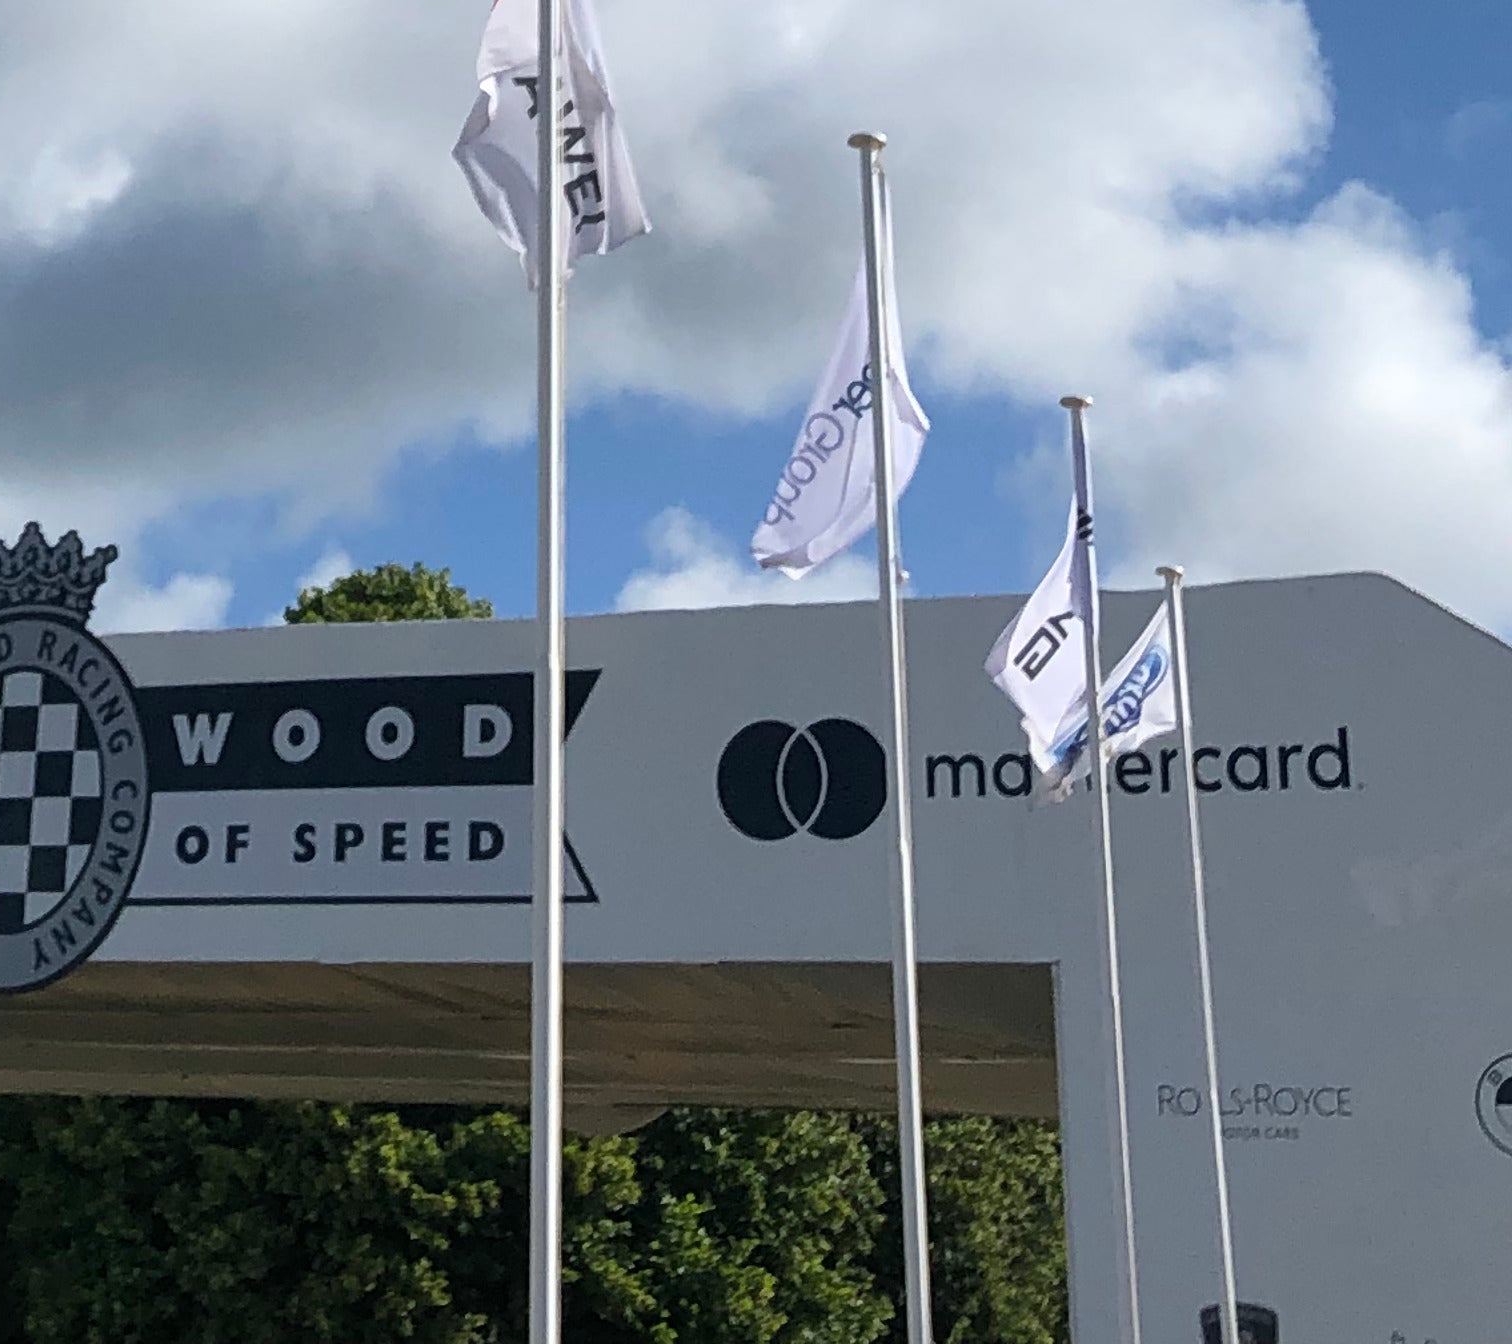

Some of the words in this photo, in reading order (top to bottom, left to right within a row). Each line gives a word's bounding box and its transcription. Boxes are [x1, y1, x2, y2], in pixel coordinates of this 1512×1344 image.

[37, 629, 135, 754] RACING
[172, 704, 514, 766] WOOD
[925, 724, 1352, 799] maercard
[32, 779, 138, 972] COMPANY
[175, 824, 250, 864] OF
[292, 820, 505, 864] SPEED
[1157, 1083, 1353, 1117] ROLS-ROYCE
